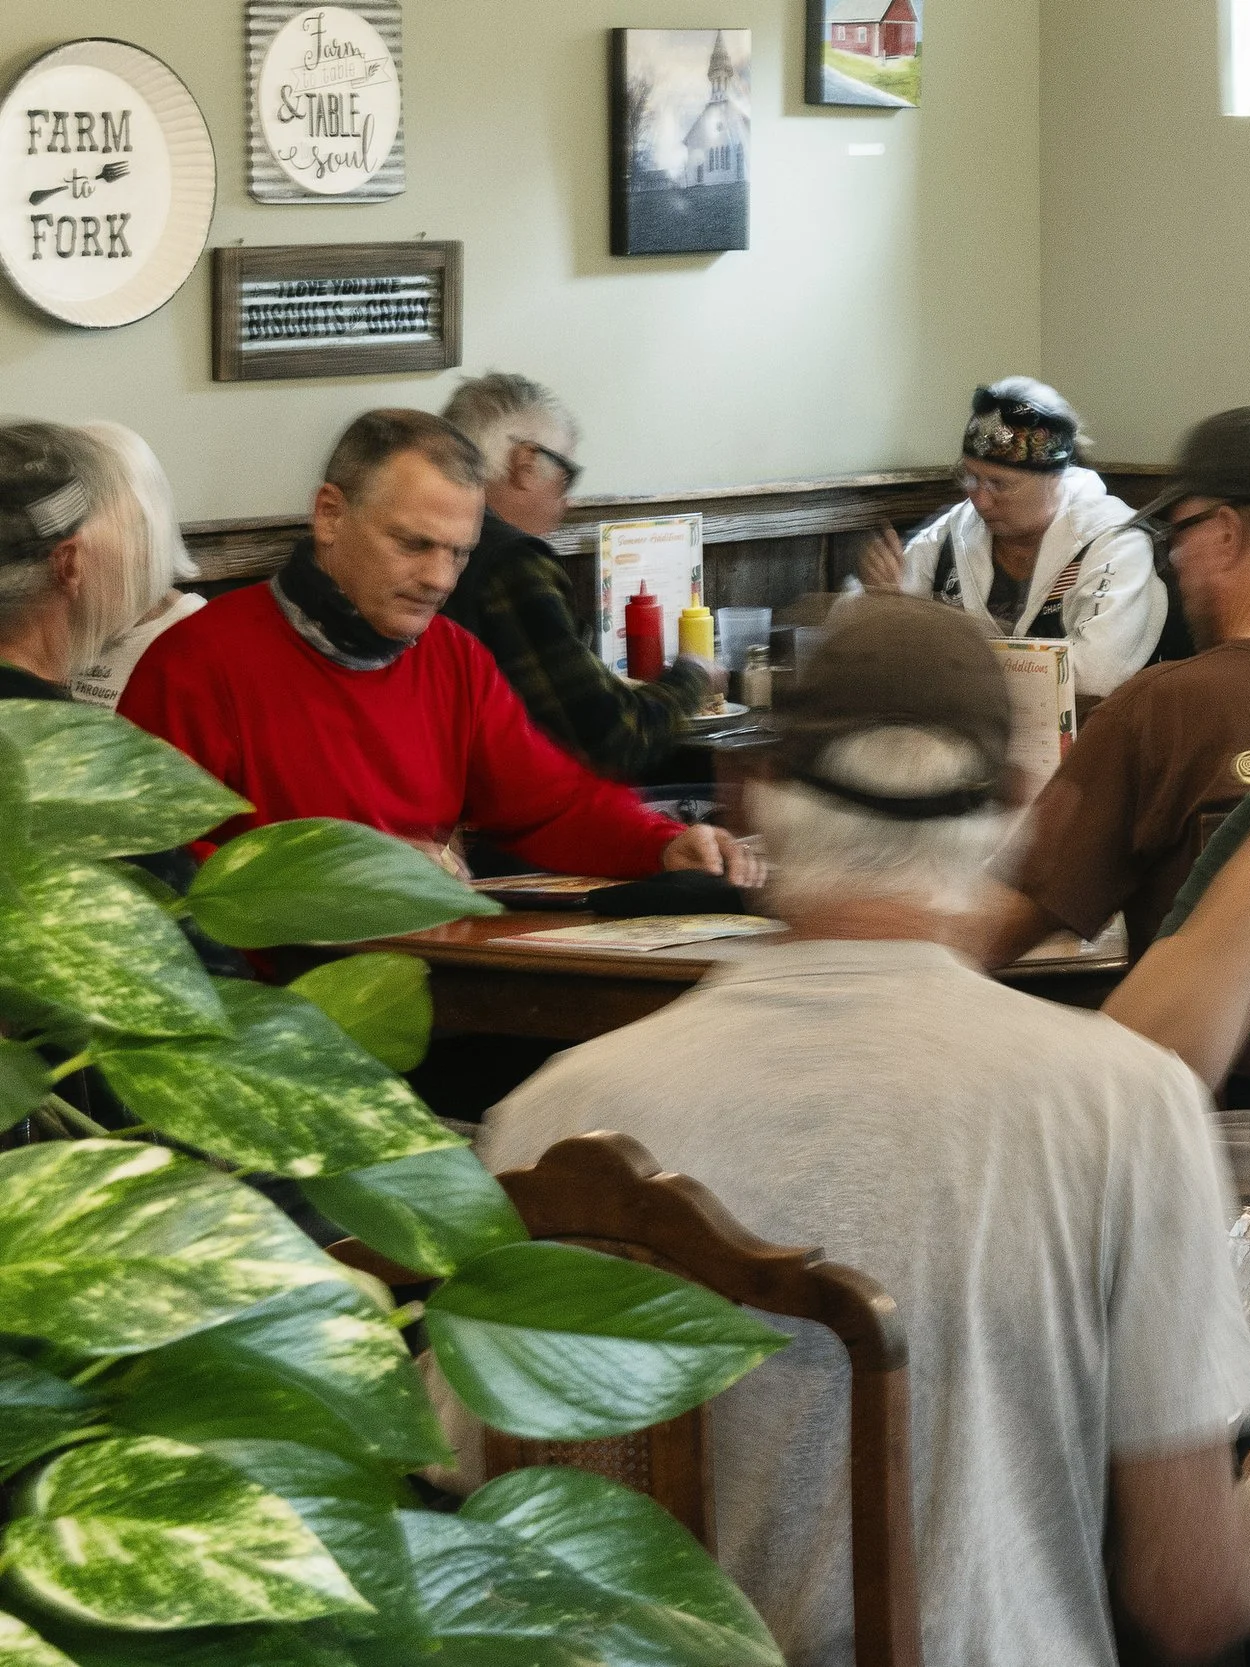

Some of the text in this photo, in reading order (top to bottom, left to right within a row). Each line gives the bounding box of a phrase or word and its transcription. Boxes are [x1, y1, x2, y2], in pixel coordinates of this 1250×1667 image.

[302, 12, 364, 71] Farm
[323, 62, 356, 85] table
[27, 109, 134, 155] FARM
[277, 85, 361, 138] & TABLE
[278, 114, 377, 179] soul
[64, 168, 96, 199] to
[30, 212, 133, 260] FORK
[278, 278, 400, 298] I LOVE YOU LIKE
[247, 300, 346, 340] BISCUITS
[365, 297, 431, 334] GRAVY
[1003, 658, 1048, 673] Additions
[75, 681, 119, 700] THROUGH
